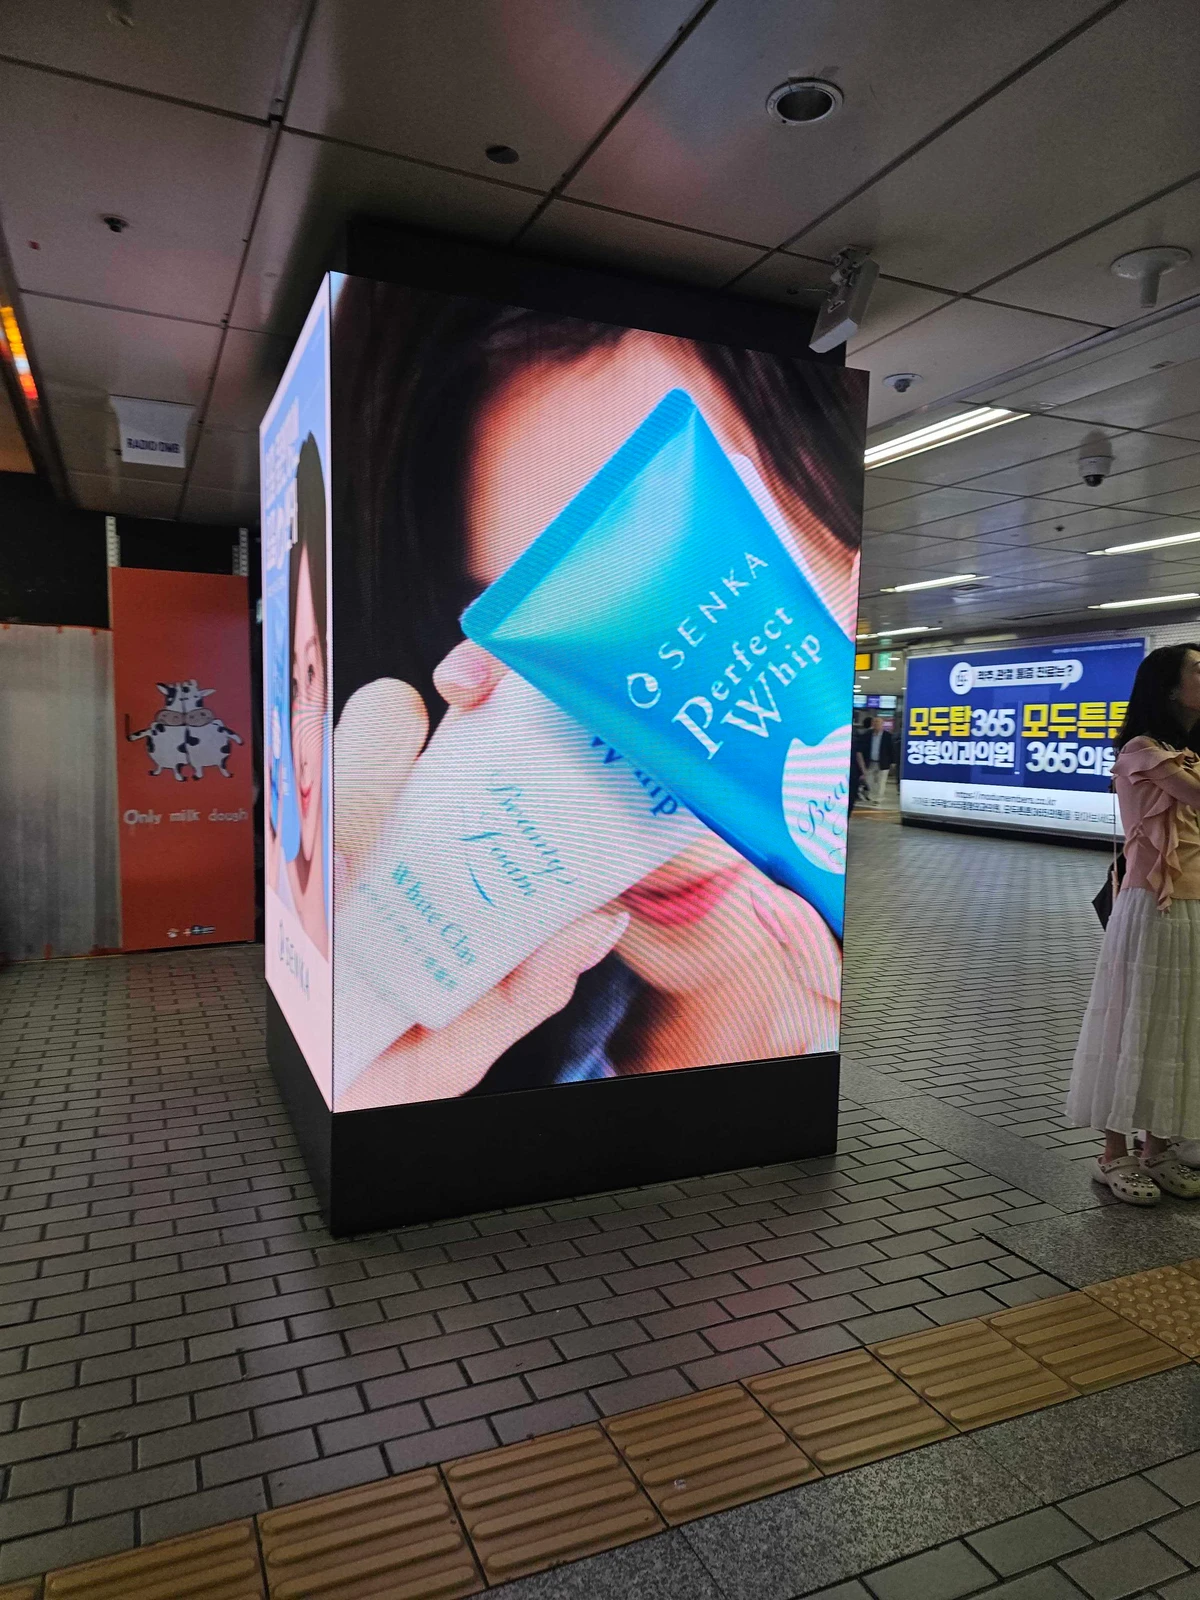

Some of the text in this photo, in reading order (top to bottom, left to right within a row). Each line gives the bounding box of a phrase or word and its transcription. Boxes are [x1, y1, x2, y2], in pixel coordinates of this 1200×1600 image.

[126, 438, 157, 451] RADIO
[657, 552, 769, 671] SENKA
[671, 606, 794, 760] Perfect
[720, 632, 822, 739] Whip
[907, 705, 1016, 737] 모두탑365
[907, 739, 1016, 768] 정형외과의원
[123, 808, 248, 825] Only milk dough
